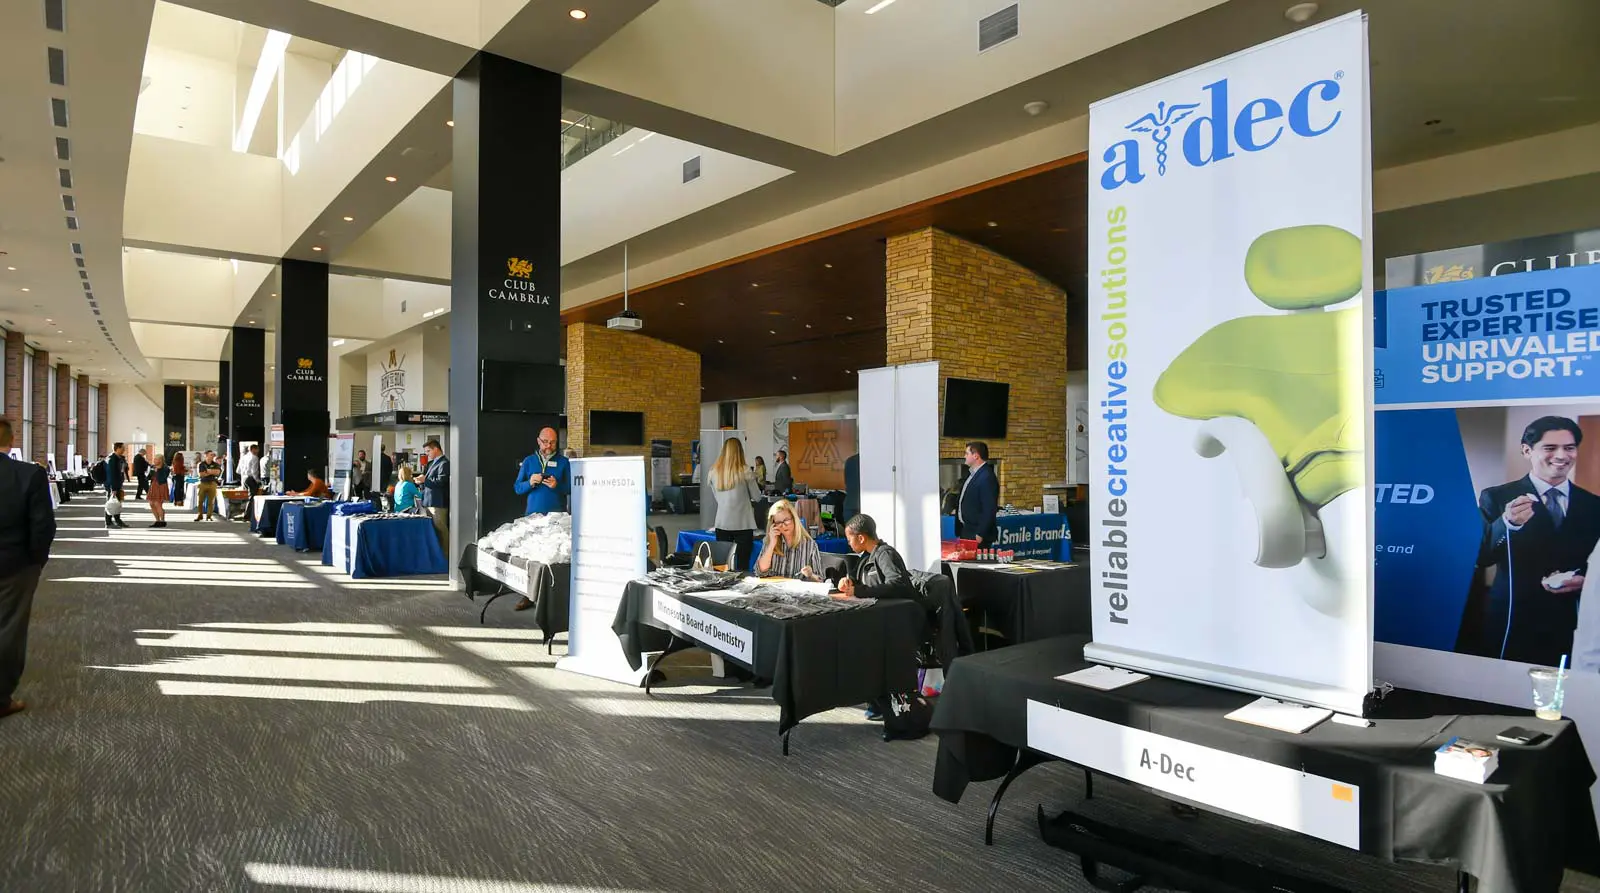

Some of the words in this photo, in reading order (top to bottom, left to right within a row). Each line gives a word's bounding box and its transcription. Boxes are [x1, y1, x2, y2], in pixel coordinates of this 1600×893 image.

[504, 278, 536, 292] CLUB
[488, 288, 550, 305] CAMBRIA
[1421, 288, 1571, 321] TRUSTED
[1422, 307, 1599, 342] EXPERTISE
[286, 373, 322, 382] CAMBRIA
[1002, 526, 1032, 545] Smile
[1034, 523, 1072, 541] Brands
[1387, 544, 1415, 555] and
[657, 600, 686, 623] Minnesota
[686, 613, 704, 632] Board
[704, 624, 713, 636] of
[712, 625, 746, 653] Dentistry
[1139, 748, 1196, 782] A-Dec
